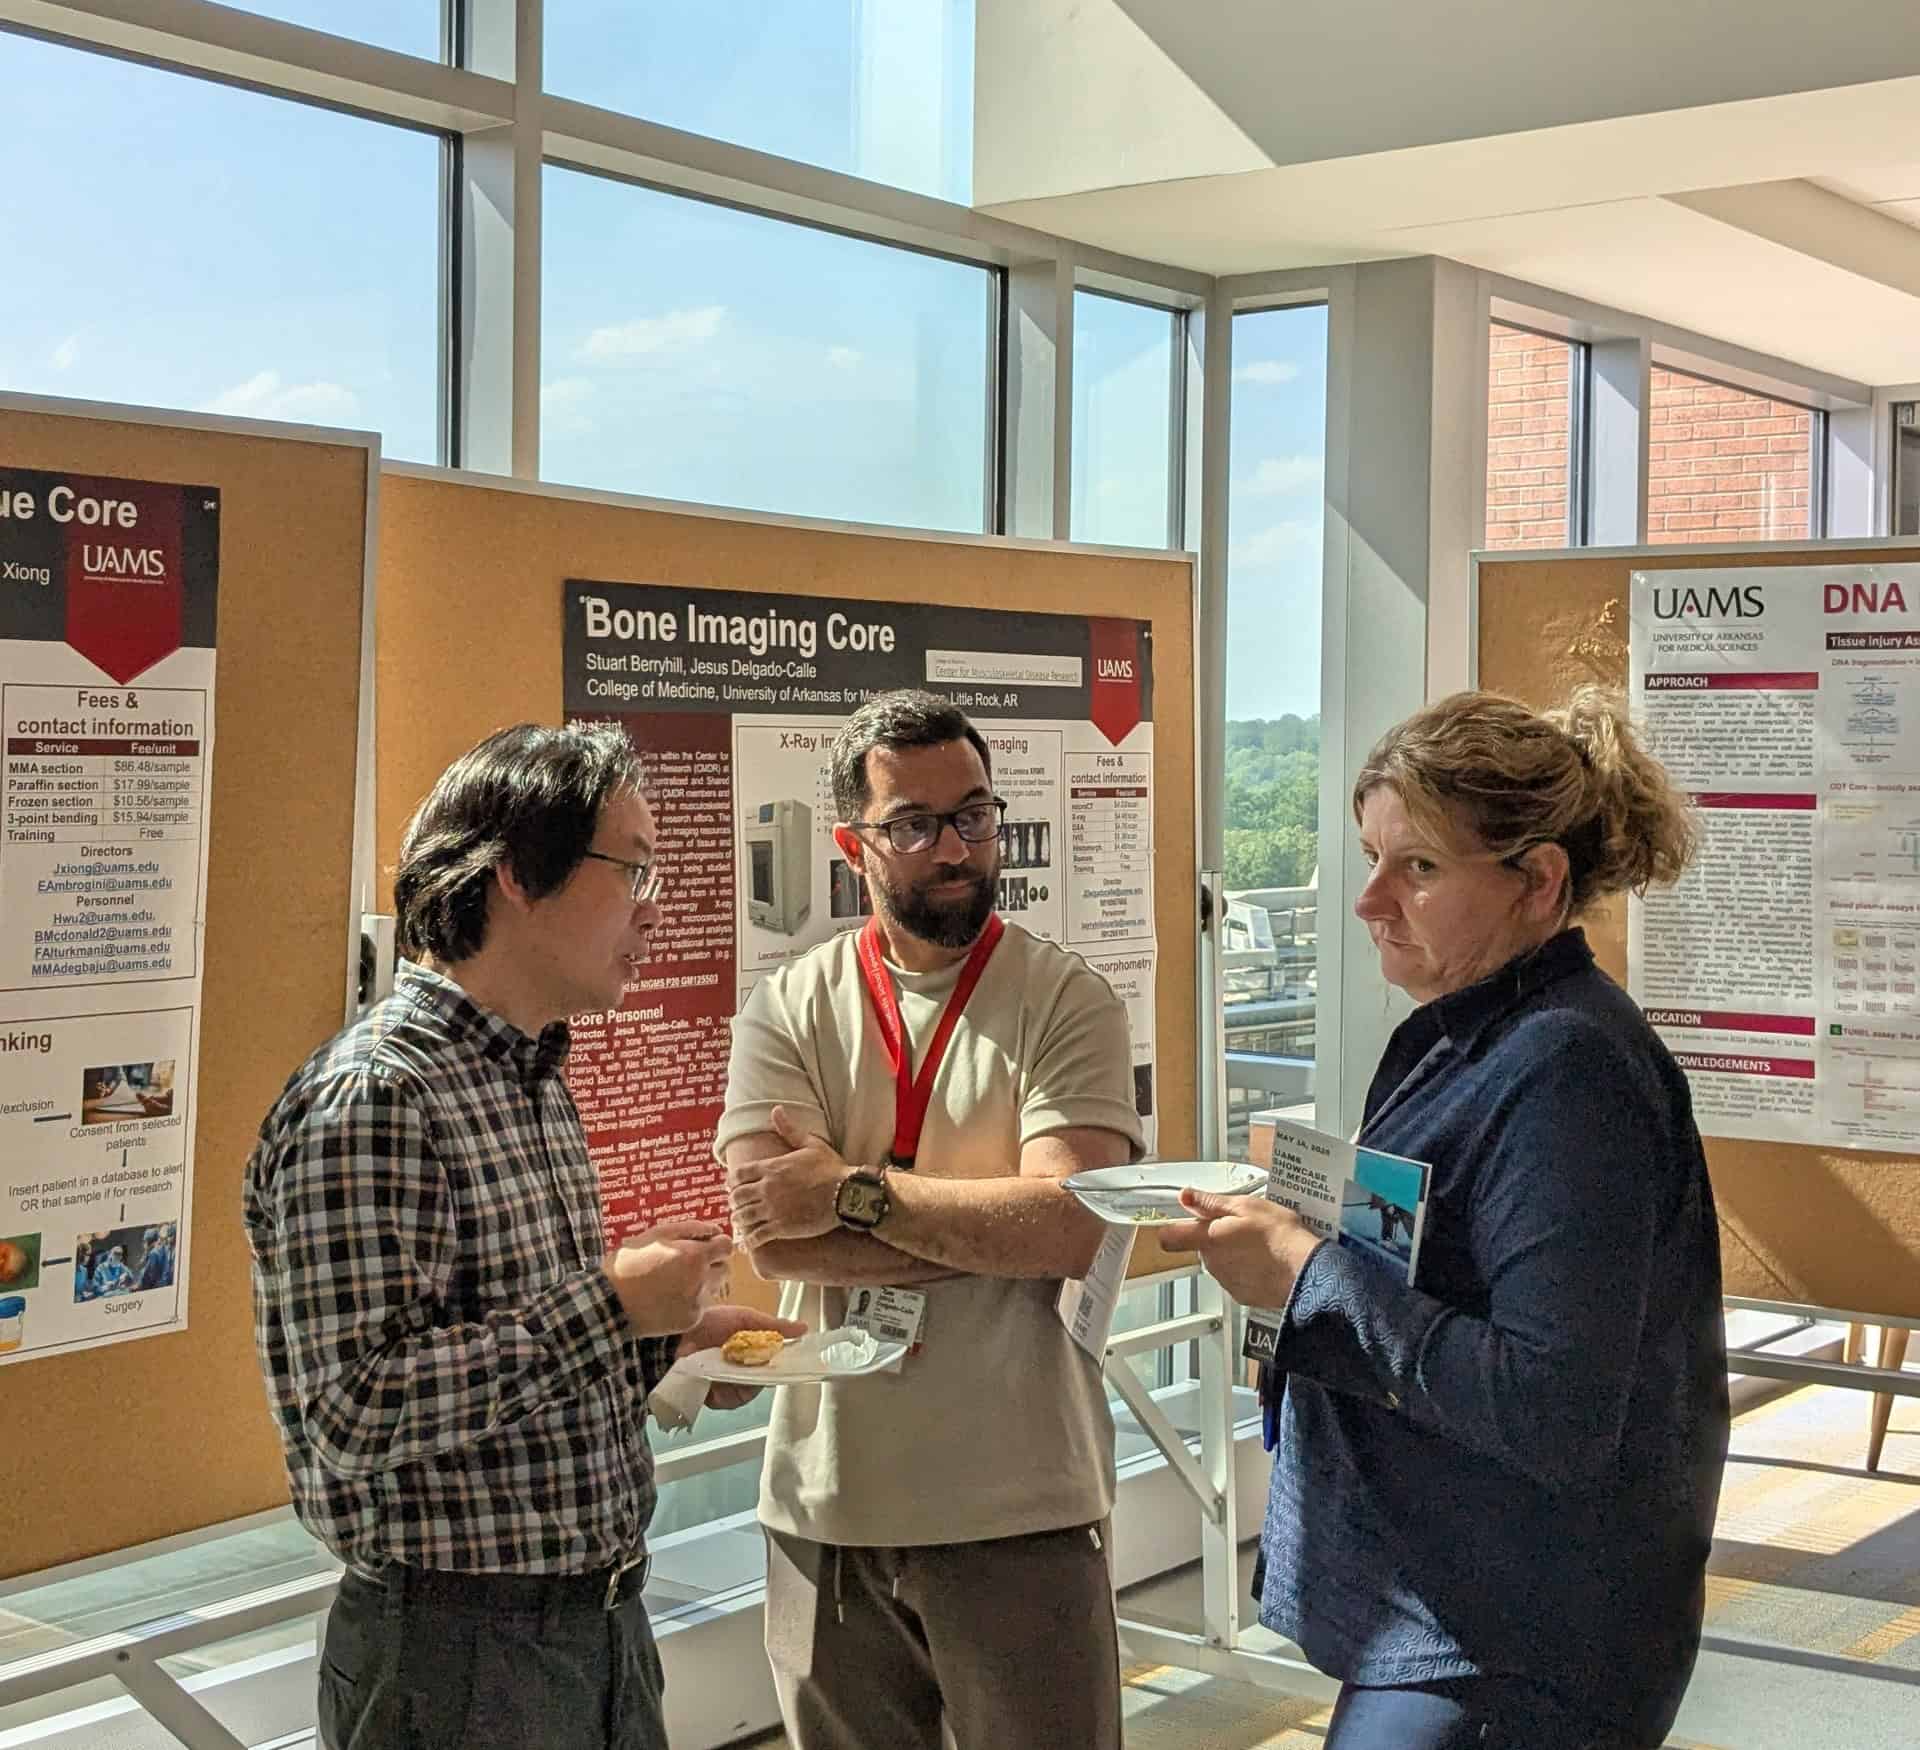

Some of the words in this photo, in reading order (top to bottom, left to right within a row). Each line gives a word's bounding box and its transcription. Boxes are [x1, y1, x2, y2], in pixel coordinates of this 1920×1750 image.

[48, 486, 138, 528] Core
[83, 544, 165, 577] UAMS
[2, 562, 50, 585] Xiong
[1653, 586, 1764, 619] UAMS
[1823, 583, 1907, 614] DNA
[585, 597, 678, 642] Bone
[688, 603, 817, 658] Imaging
[826, 613, 896, 653] Core
[1653, 633, 1701, 642] UNIVERSITY
[1702, 633, 1713, 641] OF
[1717, 632, 1763, 641] ARKANSAS
[1831, 637, 1865, 647] Tissue
[1869, 636, 1901, 648] Injury
[1905, 636, 1920, 645] As
[1658, 644, 1675, 652] FOR
[1677, 644, 1715, 652] MEDICAL
[1717, 643, 1758, 651] SCIENCES
[585, 653, 627, 672] Stuart
[631, 656, 687, 676] Berryhill,
[690, 658, 729, 676] Jesus
[731, 660, 817, 680] Delgado-Calle
[1097, 659, 1133, 678] UAMS
[1648, 677, 1709, 687] APPROACH
[78, 691, 119, 708] Fees
[126, 692, 139, 709] &
[586, 679, 638, 700] College
[642, 680, 655, 697] of
[658, 681, 720, 701] Medicine,
[722, 686, 777, 704] University
[780, 686, 790, 701] of
[792, 687, 841, 704] Arkansas
[844, 688, 858, 703] for
[951, 692, 973, 705] Little
[976, 693, 1001, 707] Rock,
[1003, 693, 1018, 707] AR
[18, 718, 87, 736] contact
[92, 718, 194, 736] information
[35, 742, 79, 754] Service
[130, 743, 176, 755] Fee/unit
[780, 734, 816, 752] X-Ray
[986, 736, 1028, 754] Imaging
[9, 762, 38, 774] MMA
[41, 763, 83, 774] section
[1097, 755, 1115, 766] Fees
[1117, 756, 1123, 766] &
[8, 779, 54, 791] Paraffin
[58, 781, 98, 791] section
[1072, 773, 1101, 783] contact
[1103, 772, 1146, 784] information
[8, 796, 48, 807] Frozen
[52, 797, 93, 807] section
[8, 813, 49, 827] 3-point
[52, 813, 98, 825] bending
[7, 830, 55, 842] Training
[139, 827, 163, 838] Free
[80, 846, 133, 857] Directors
[76, 894, 134, 907] Personnel
[1093, 958, 1152, 975] morphometry
[570, 1013, 603, 1026] Core
[608, 1004, 664, 1024] Personnel
[1647, 1012, 1701, 1025] LOCATION
[1674, 1055, 1771, 1072] OWLEDGEMENTS
[70, 1124, 113, 1139] Consent
[116, 1121, 139, 1133] from
[142, 1116, 181, 1130] selected
[106, 1137, 146, 1152] patients
[1277, 1132, 1294, 1143] MAY
[1274, 1148, 1301, 1164] UAMS
[1272, 1157, 1327, 1182] SHOWCASE
[9, 1184, 40, 1196] Insert
[42, 1178, 77, 1194] patient
[80, 1176, 89, 1187] in
[92, 1176, 98, 1185] a
[101, 1169, 148, 1185] database
[151, 1167, 160, 1177] to
[163, 1163, 183, 1176] alert
[1272, 1167, 1284, 1176] OF
[1287, 1172, 1331, 1193] MEDICAL
[20, 1199, 39, 1211] OR
[42, 1196, 61, 1208] that
[64, 1190, 100, 1206] sample
[104, 1187, 109, 1197] if
[113, 1185, 127, 1197] for
[129, 1181, 173, 1196] research
[1270, 1176, 1336, 1203] DISCOVERIES
[1269, 1194, 1301, 1209] CORE
[105, 1298, 143, 1315] Surgery
